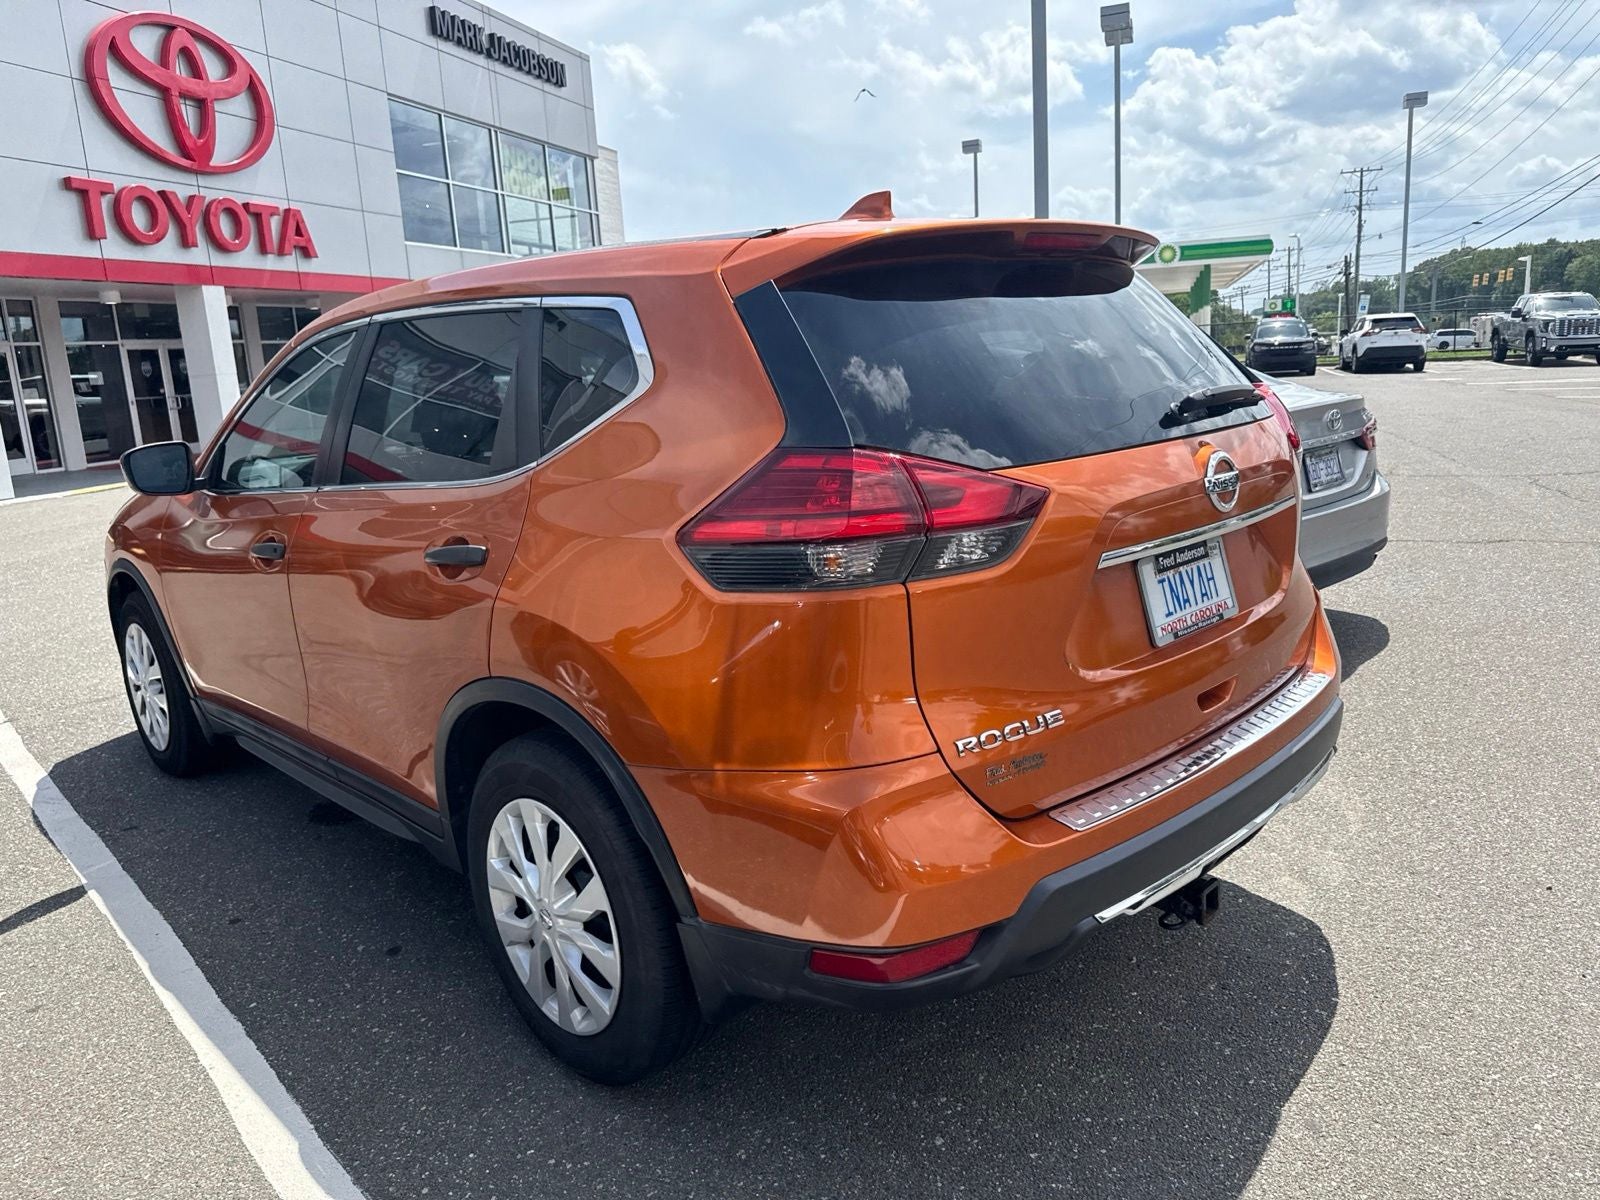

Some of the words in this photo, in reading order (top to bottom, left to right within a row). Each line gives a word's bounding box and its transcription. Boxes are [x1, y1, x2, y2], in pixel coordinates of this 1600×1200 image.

[429, 6, 486, 55] MARK
[486, 32, 567, 88] JACOBSON
[63, 176, 319, 259] TOYOTA
[1176, 546, 1206, 562] Anderson
[1157, 561, 1219, 618] INAYAH
[1160, 617, 1188, 635] NORTH
[1190, 600, 1229, 624] CAROLINA
[954, 709, 1065, 757] ROGUE
